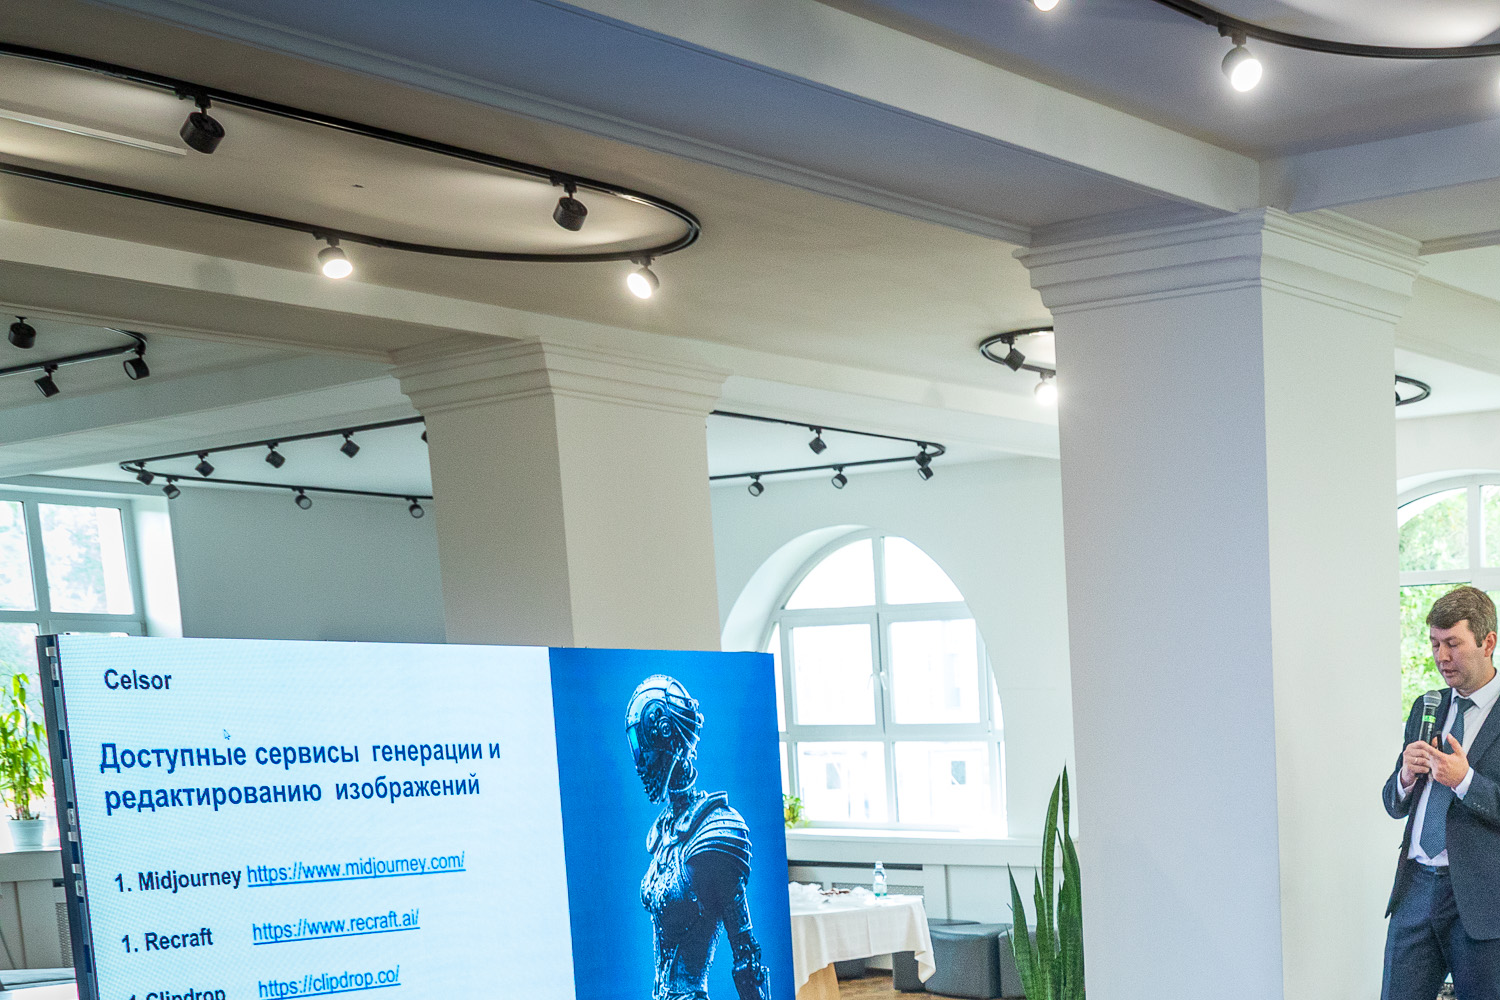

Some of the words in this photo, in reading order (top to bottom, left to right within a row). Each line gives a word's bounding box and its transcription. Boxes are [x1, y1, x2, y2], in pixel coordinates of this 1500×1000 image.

[104, 668, 172, 690] Celsor
[100, 742, 247, 774] Доступные
[255, 745, 359, 771] сервисы
[372, 742, 483, 767] генерации
[488, 742, 501, 759] и
[104, 783, 322, 817] редактированию
[335, 773, 480, 804] изображений
[114, 873, 132, 893] 1.
[138, 870, 242, 894] Midjourney
[247, 851, 466, 887] https://www.midjourney.com/
[121, 934, 138, 953] 1.
[144, 927, 214, 951] Recraft
[252, 908, 420, 945] https://www.recraft.ai/
